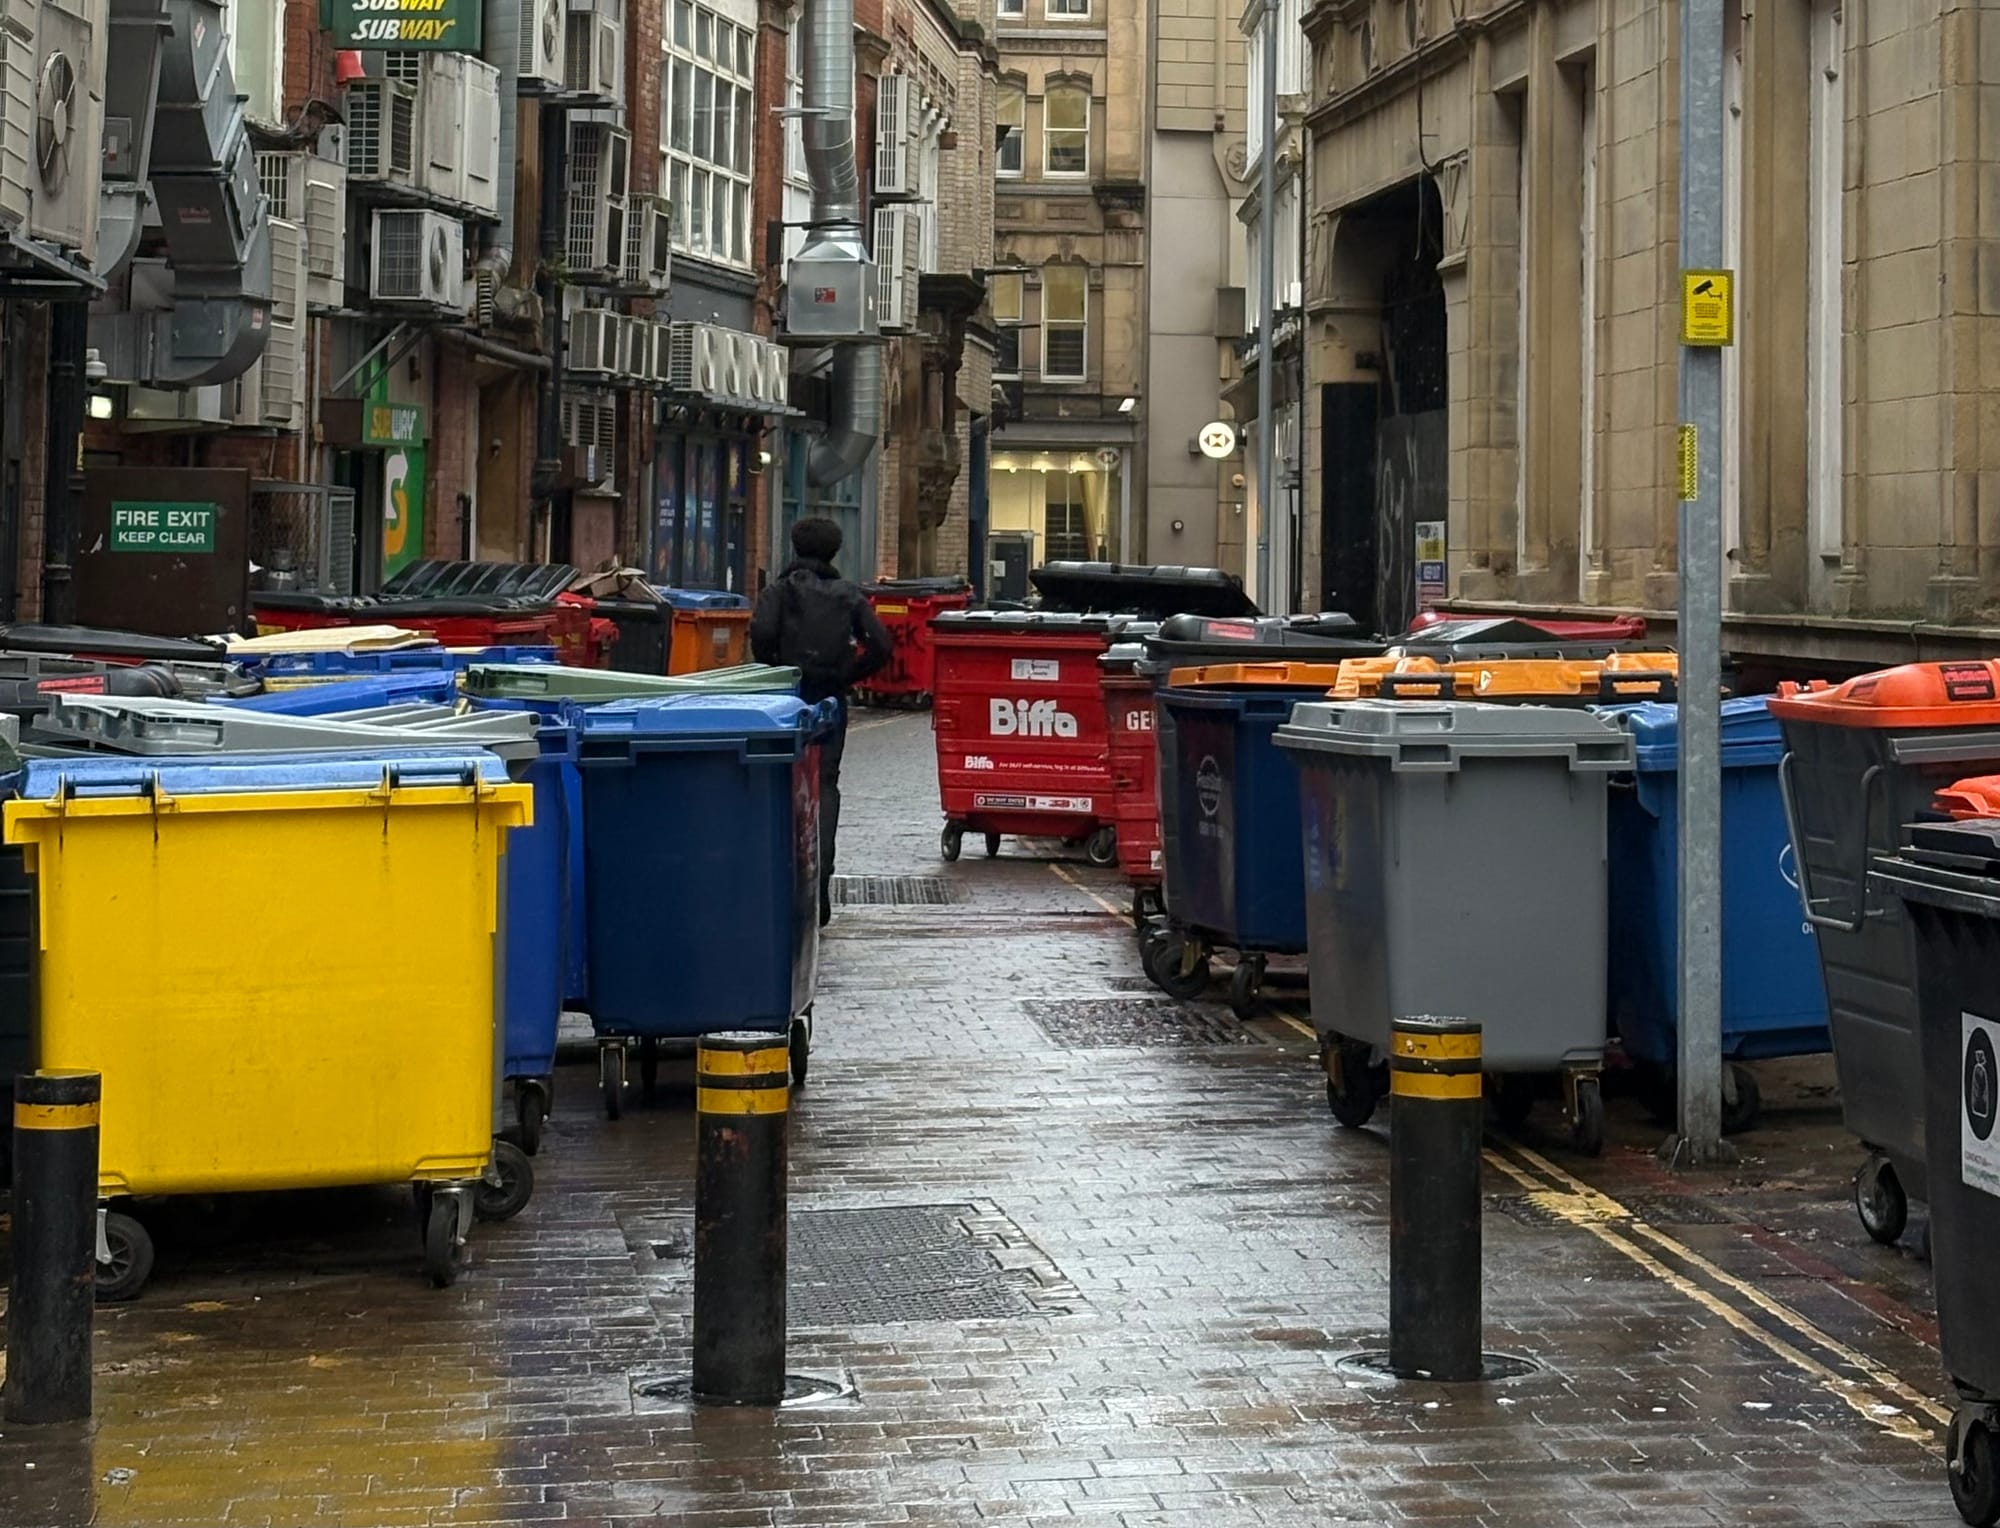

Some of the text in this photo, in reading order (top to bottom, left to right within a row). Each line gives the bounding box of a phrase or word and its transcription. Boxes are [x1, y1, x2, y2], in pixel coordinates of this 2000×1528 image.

[351, 18, 456, 40] SUBWAY
[116, 510, 210, 527] FIRE EXIT
[118, 531, 205, 544] KEEP CLEAR
[990, 698, 1078, 737] Biffa
[1126, 710, 1155, 731] GE
[964, 755, 994, 770] Biffa
